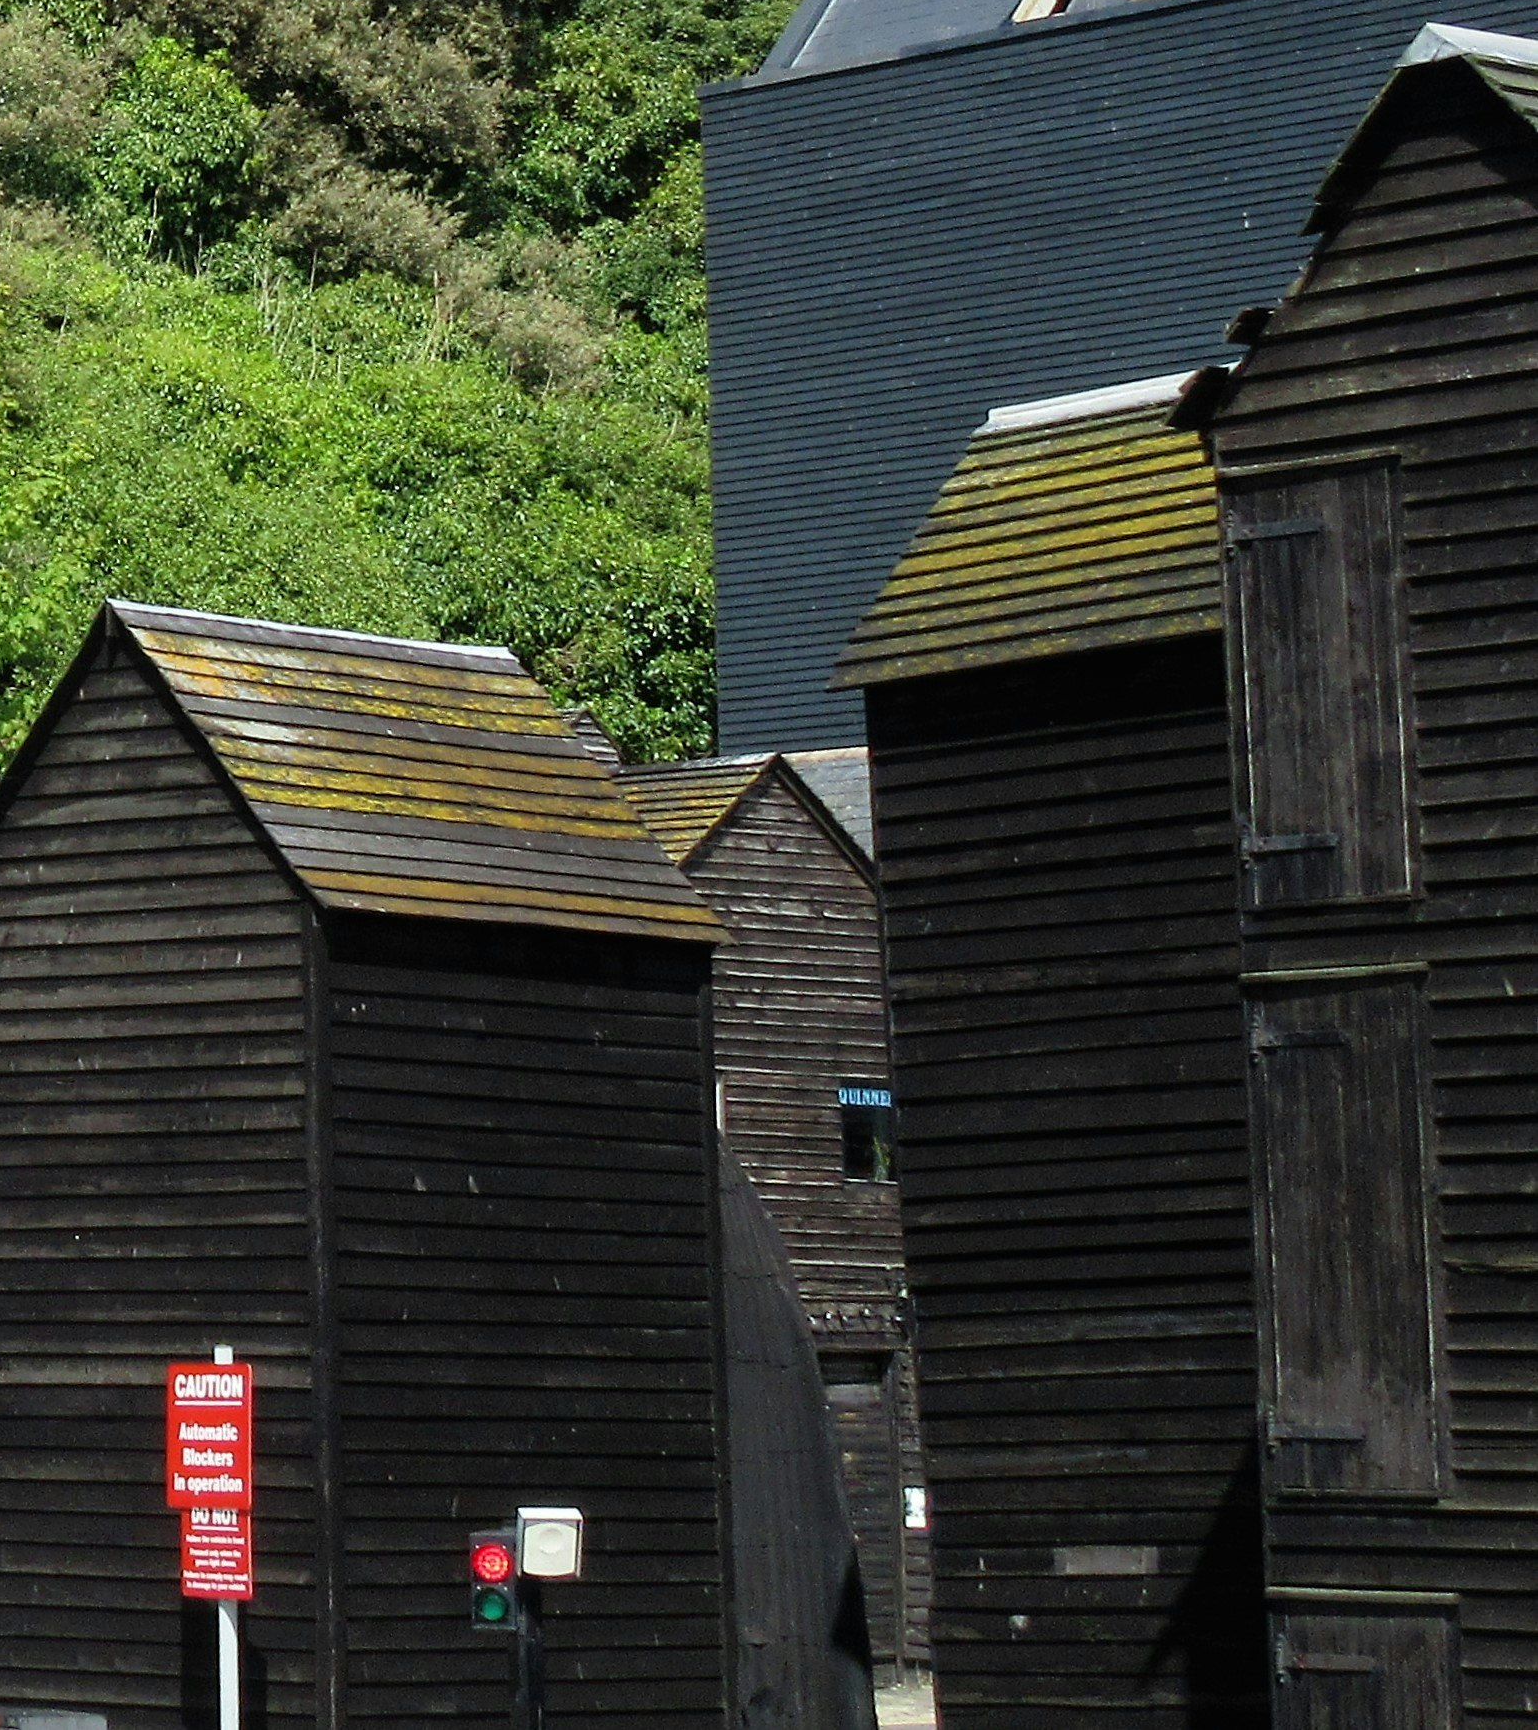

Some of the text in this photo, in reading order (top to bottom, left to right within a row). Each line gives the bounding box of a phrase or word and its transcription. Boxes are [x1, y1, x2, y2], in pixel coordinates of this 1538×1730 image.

[174, 1373, 243, 1399] CAUTION
[178, 1421, 239, 1442] Automatic
[182, 1447, 234, 1468] Blockers
[187, 1473, 243, 1496] operation
